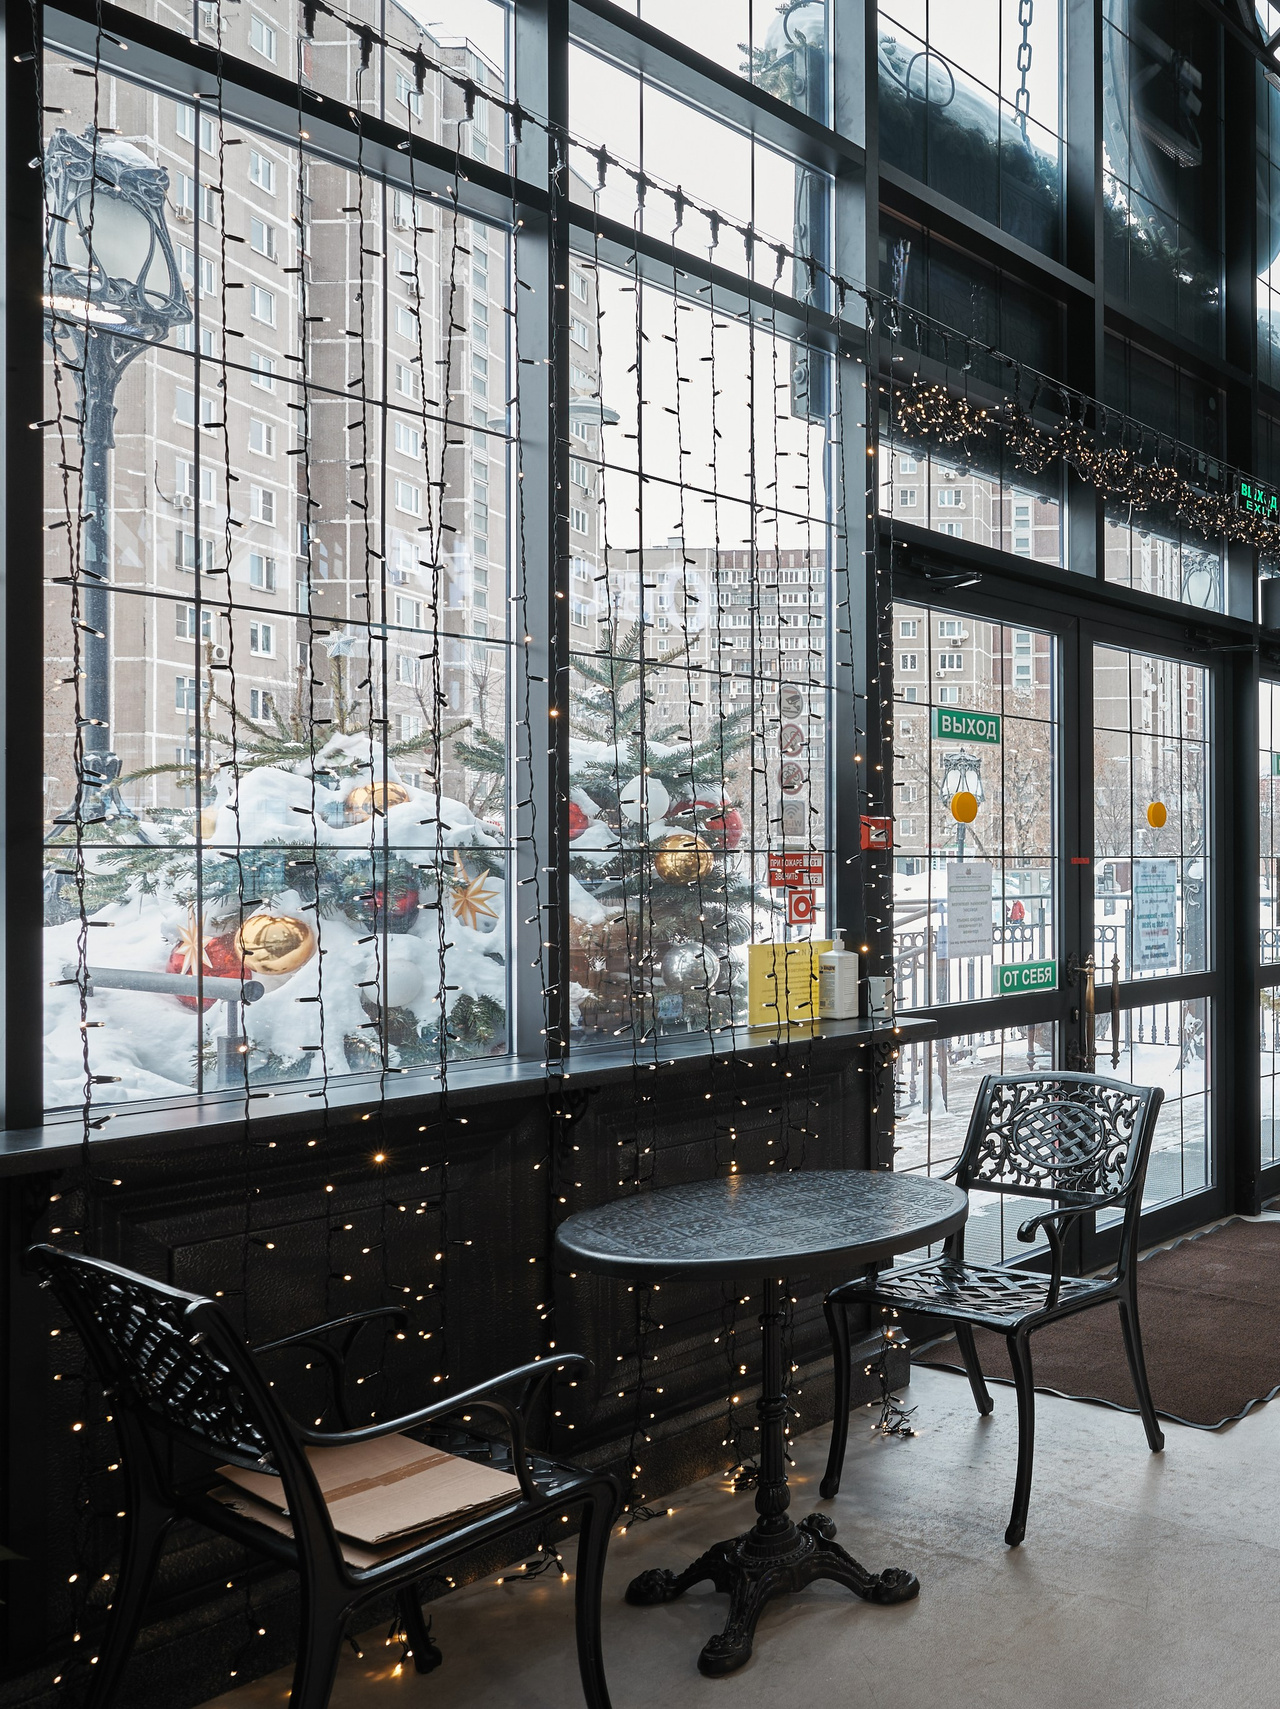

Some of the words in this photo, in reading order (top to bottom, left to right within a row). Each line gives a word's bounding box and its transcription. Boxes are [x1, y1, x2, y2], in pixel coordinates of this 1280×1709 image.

[1241, 482, 1278, 514] ВЫХД
[1246, 499, 1272, 518] EXIT
[942, 715, 997, 741] ВЫХОД
[770, 859, 781, 867] ПРИ
[774, 872, 799, 881] ЗВОНИТЬ
[1003, 970, 1019, 988] ОТ
[1022, 967, 1052, 985] СЕБЯ
